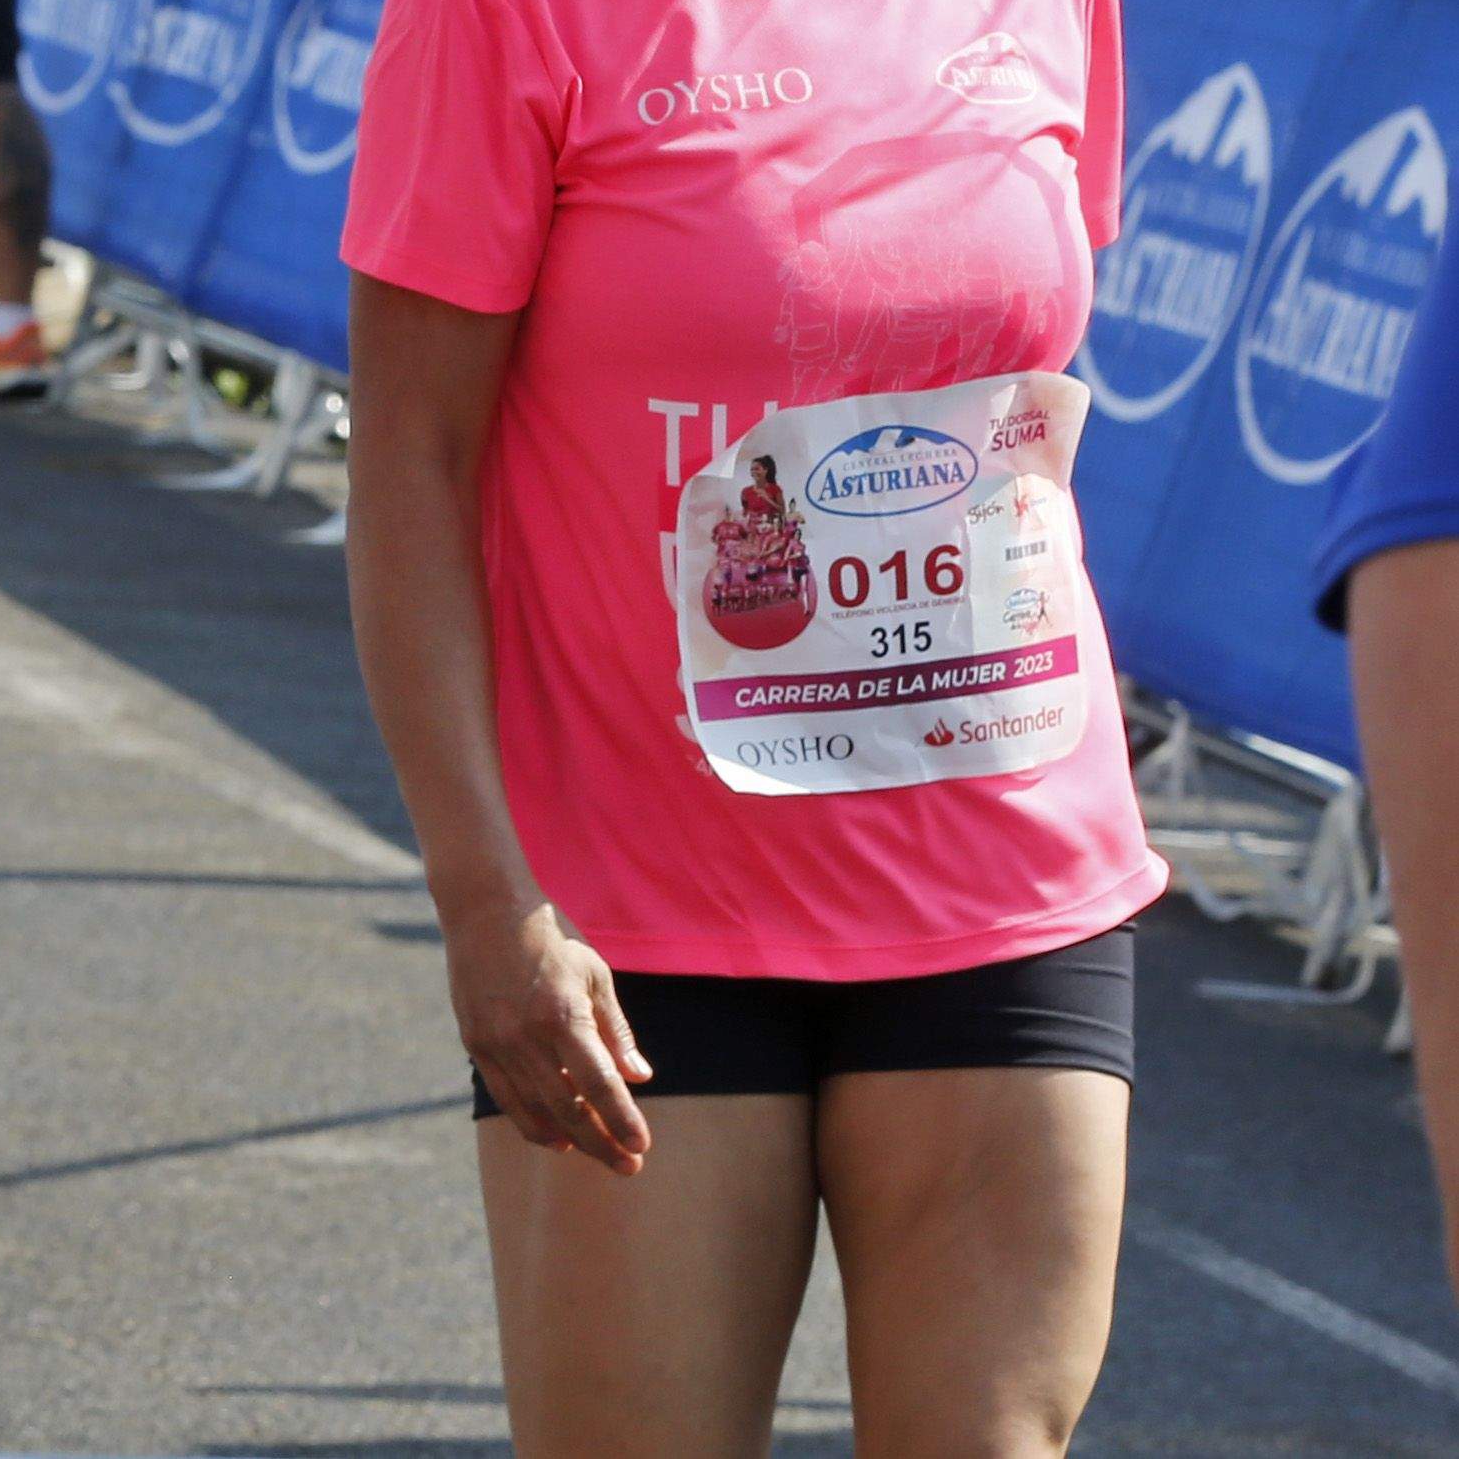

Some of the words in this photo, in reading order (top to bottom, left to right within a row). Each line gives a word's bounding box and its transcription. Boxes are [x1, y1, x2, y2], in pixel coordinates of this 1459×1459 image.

[636, 66, 814, 127] OYSHO
[989, 418, 1006, 431] TU
[990, 423, 1047, 452] SUMA
[817, 462, 967, 502] ASTURIANA
[828, 544, 965, 609] 016
[870, 620, 933, 659] 315
[734, 682, 850, 709] CARRERA
[857, 678, 890, 701] DE
[896, 674, 927, 696] LA
[931, 662, 1006, 691] MUJER
[1013, 649, 1054, 678] 2023
[959, 704, 1065, 746] Santander
[737, 732, 855, 768] OYSHO
